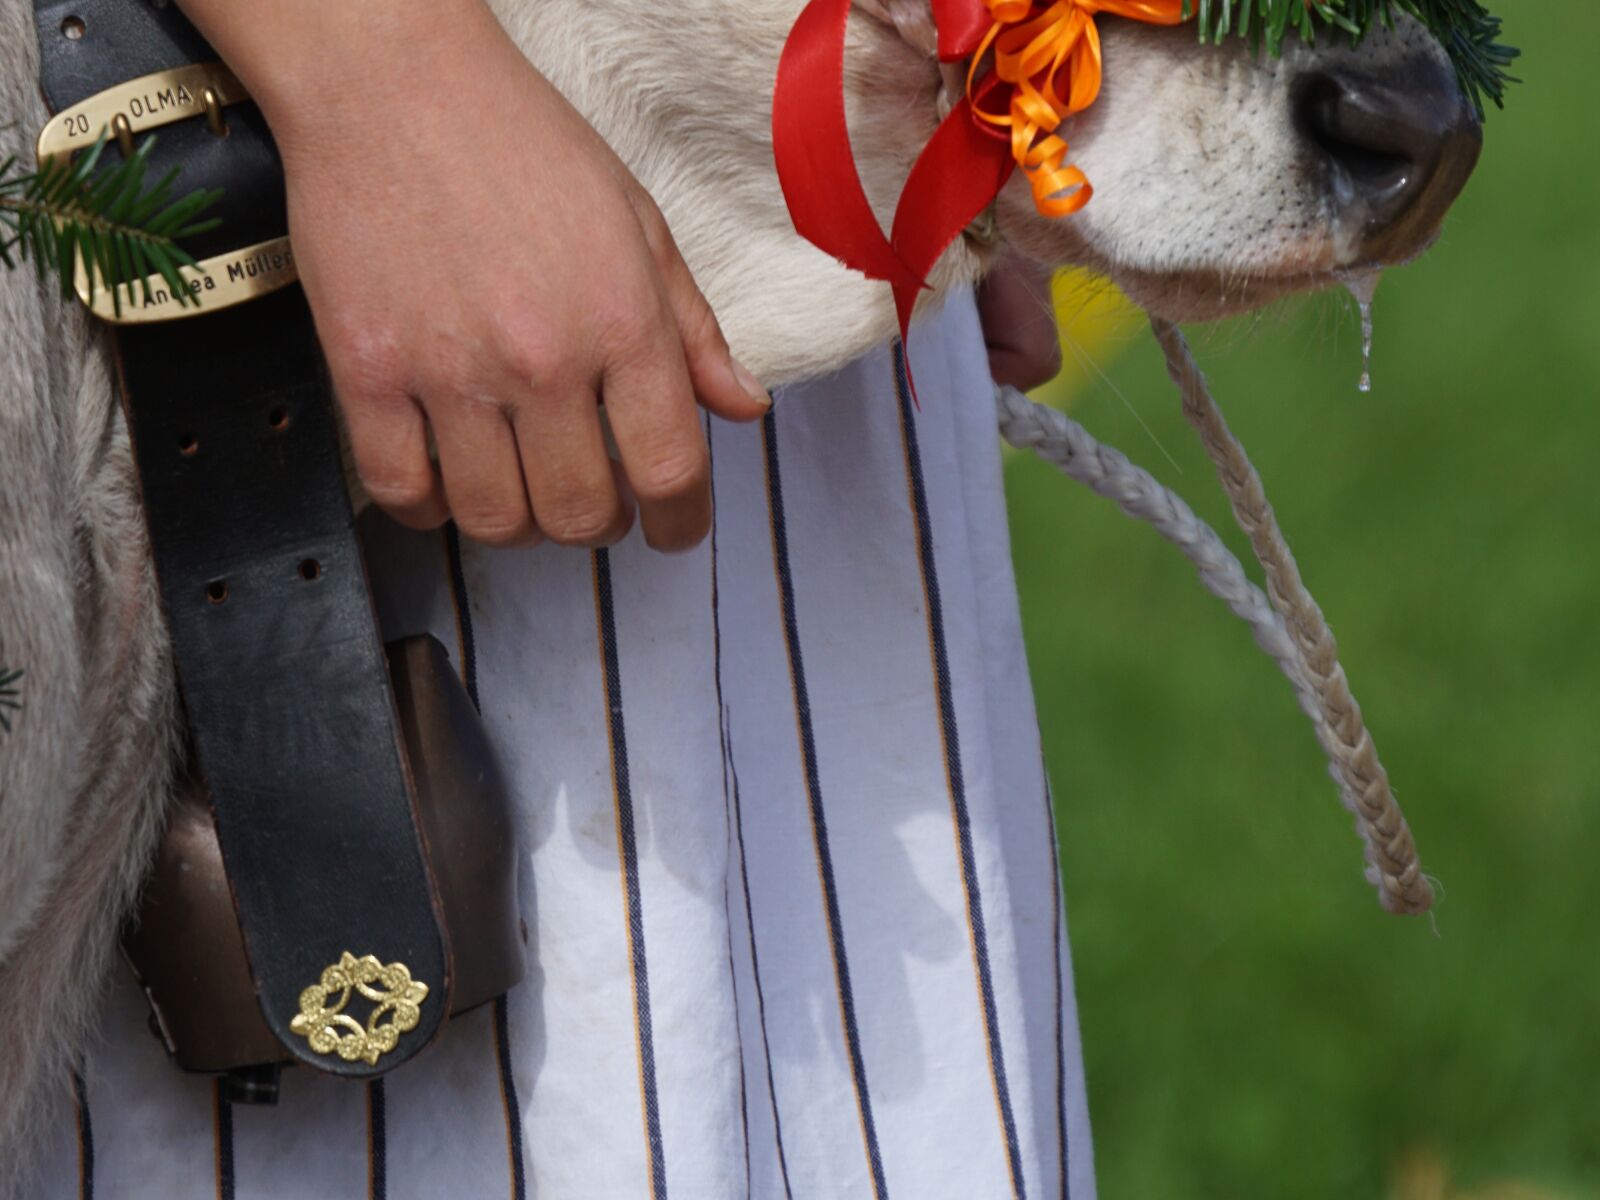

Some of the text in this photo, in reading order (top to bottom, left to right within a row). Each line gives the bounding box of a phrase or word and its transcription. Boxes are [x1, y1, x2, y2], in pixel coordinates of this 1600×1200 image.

[64, 86, 192, 137] 20 OLMA
[144, 252, 292, 308] Anea Müller
